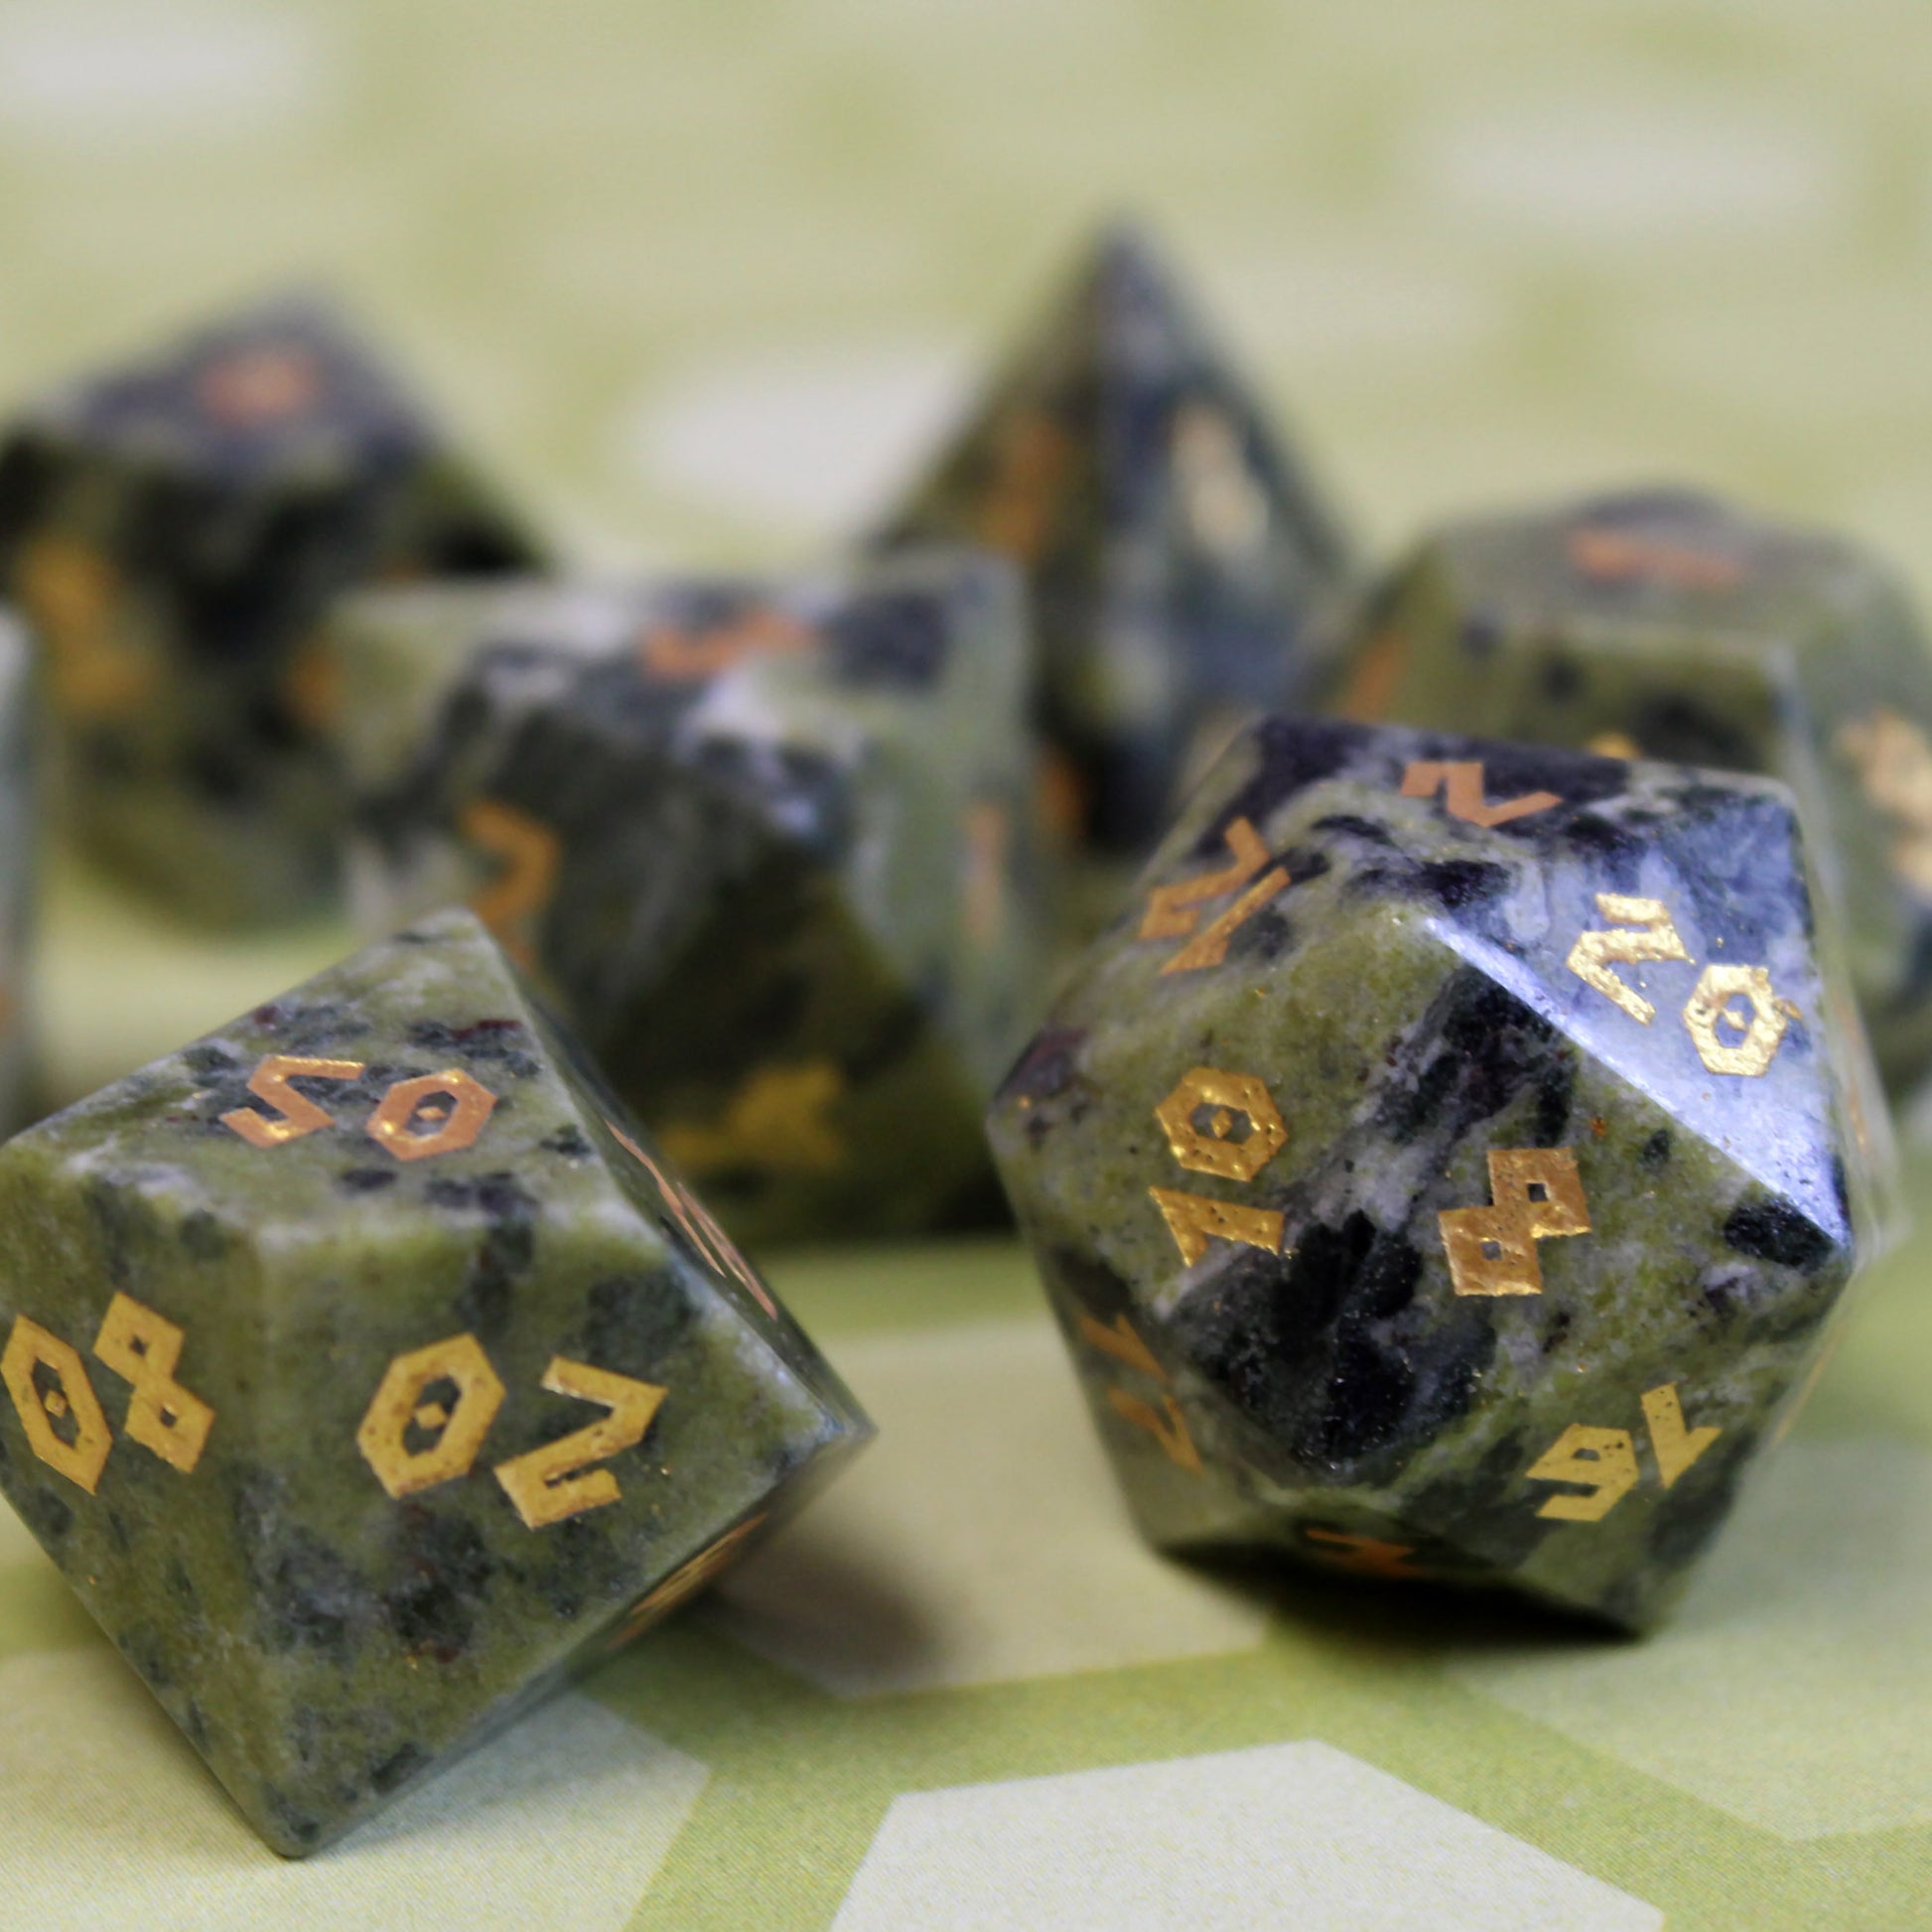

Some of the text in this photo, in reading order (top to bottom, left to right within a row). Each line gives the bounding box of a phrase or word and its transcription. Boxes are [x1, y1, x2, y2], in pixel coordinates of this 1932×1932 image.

[1139, 815, 1290, 976] 12
[1566, 893, 1788, 1078] 20
[219, 1054, 497, 1162] 50
[1149, 1065, 1291, 1268] 10
[1438, 1147, 1591, 1298] 8
